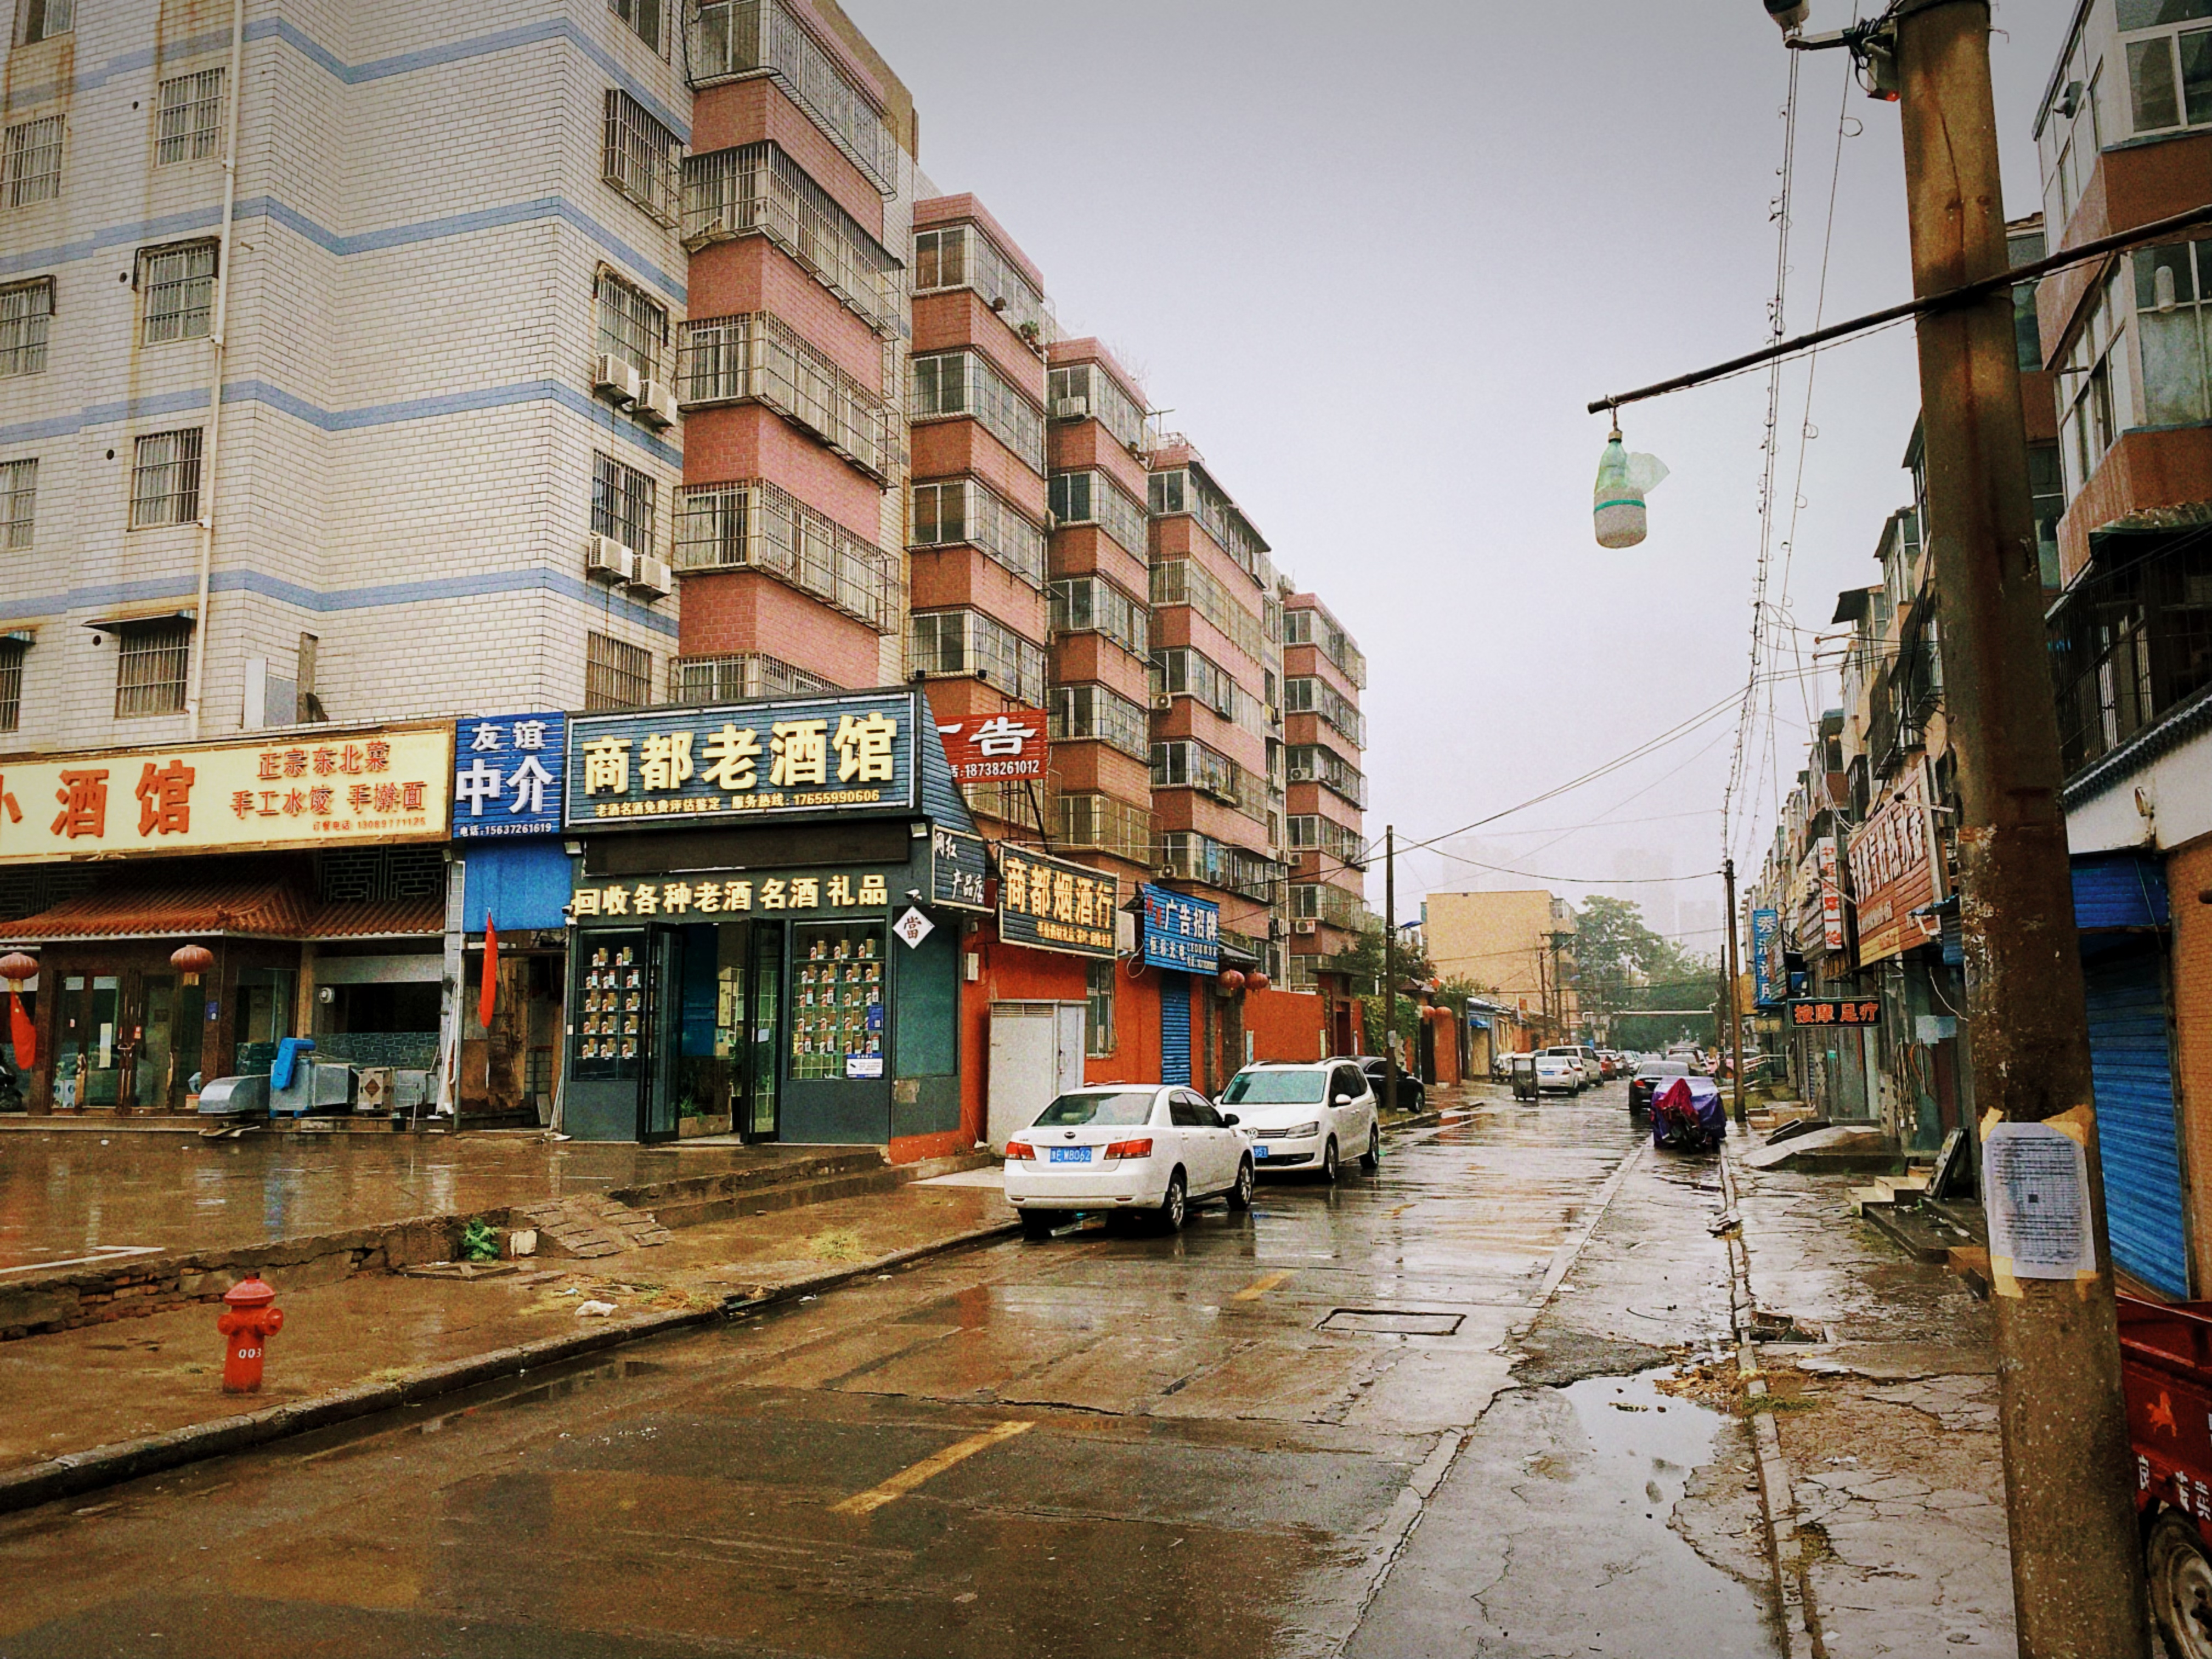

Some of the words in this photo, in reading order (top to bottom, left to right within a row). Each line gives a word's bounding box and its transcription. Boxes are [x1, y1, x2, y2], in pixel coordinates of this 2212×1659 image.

[470, 720, 546, 751] 友谊
[583, 713, 898, 795] 商都老酒馆
[937, 716, 1037, 756] 告
[257, 741, 390, 779] 正宗东北菜
[230, 785, 333, 819] 手工水饺
[347, 781, 427, 813] 手擀面
[455, 755, 554, 816] 中介
[596, 797, 720, 817] 老酒名酒免费评估鉴定
[732, 789, 880, 809] 服务热线:17655990606
[313, 820, 350, 831] 订餐电话
[460, 822, 552, 837] 电话:15637261619
[572, 881, 753, 916] 回收各种老酒
[759, 878, 820, 910] 名酒
[827, 874, 888, 907] 礼品
[1006, 857, 1114, 929] 商都烟酒行
[904, 916, 922, 939] 當
[1165, 899, 1217, 942] 广告招牌
[1795, 1004, 1835, 1024] 按摩
[1839, 1002, 1878, 1022] 足疗
[239, 1348, 262, 1359] 003
